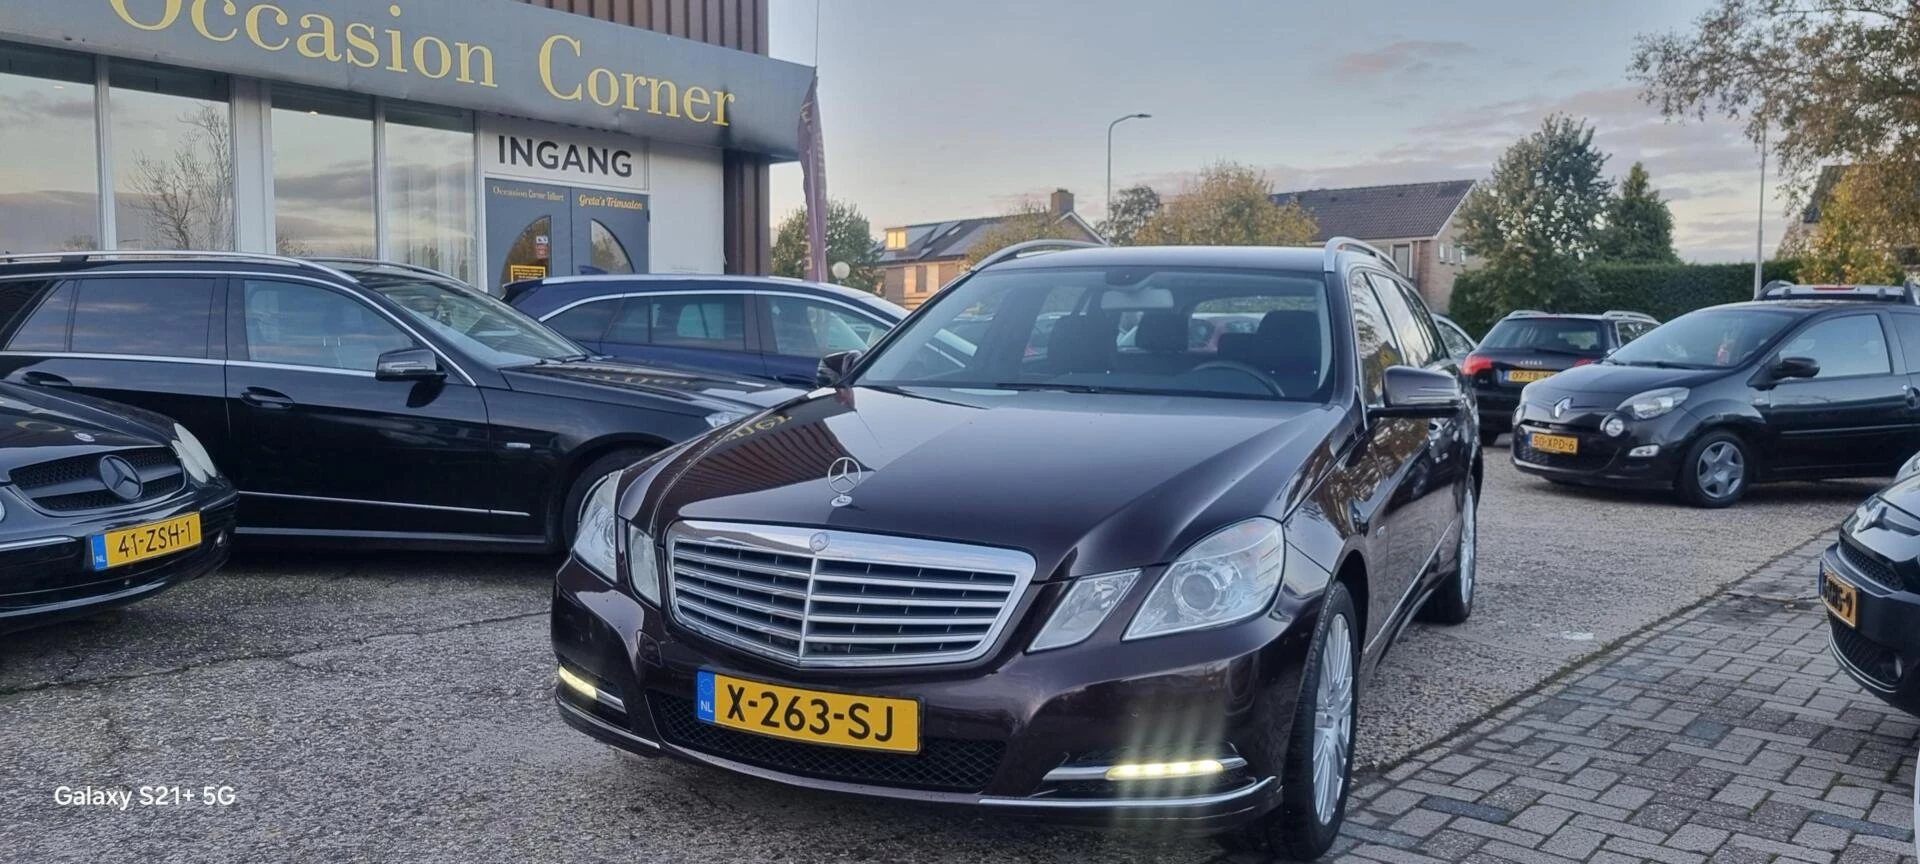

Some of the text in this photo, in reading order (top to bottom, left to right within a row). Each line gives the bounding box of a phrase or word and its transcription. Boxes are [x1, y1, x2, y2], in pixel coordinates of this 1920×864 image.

[538, 34, 736, 127] Corner
[498, 135, 633, 178] INGANG
[118, 520, 191, 558] 41-ZSH-1
[700, 700, 713, 713] NL
[727, 684, 894, 743] X-263-SJ
